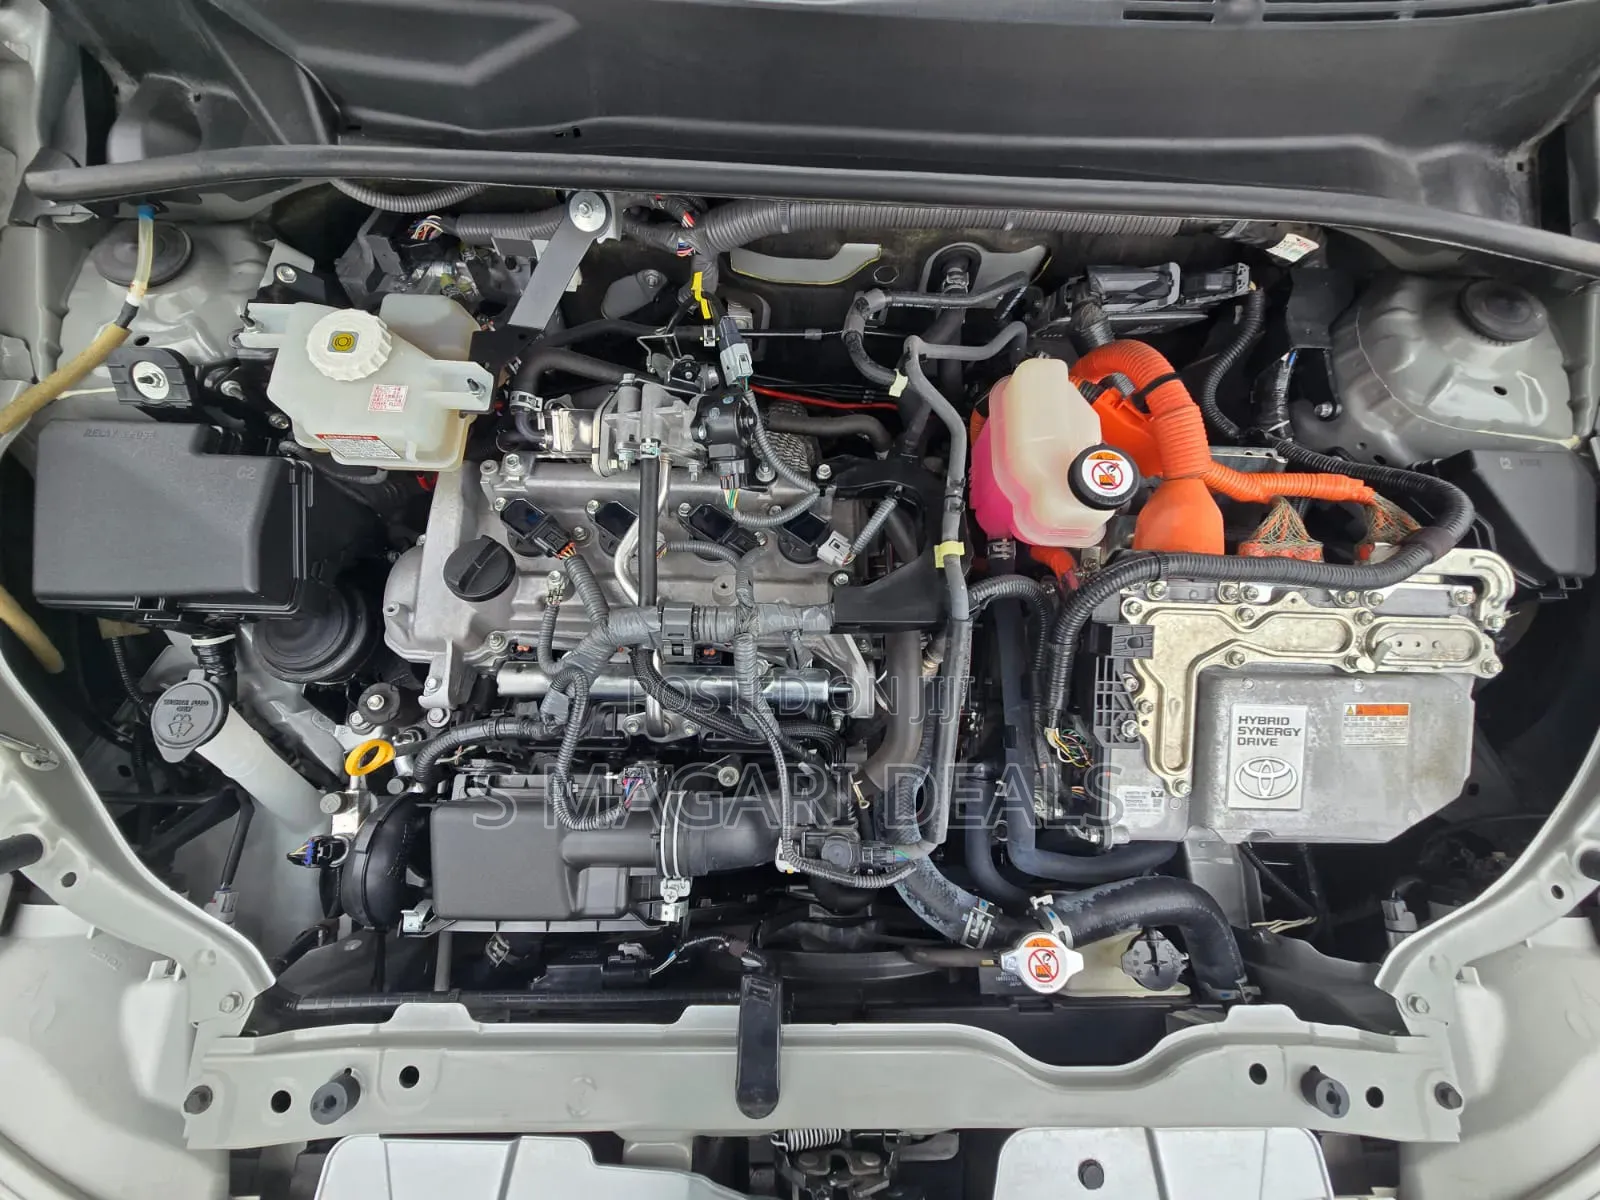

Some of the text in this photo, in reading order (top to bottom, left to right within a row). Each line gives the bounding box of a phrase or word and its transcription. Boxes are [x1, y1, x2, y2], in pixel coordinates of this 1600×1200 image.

[1238, 715, 1290, 726] HYBRID
[1237, 726, 1301, 737] SYNERGY
[1237, 736, 1279, 747] DRIVE
